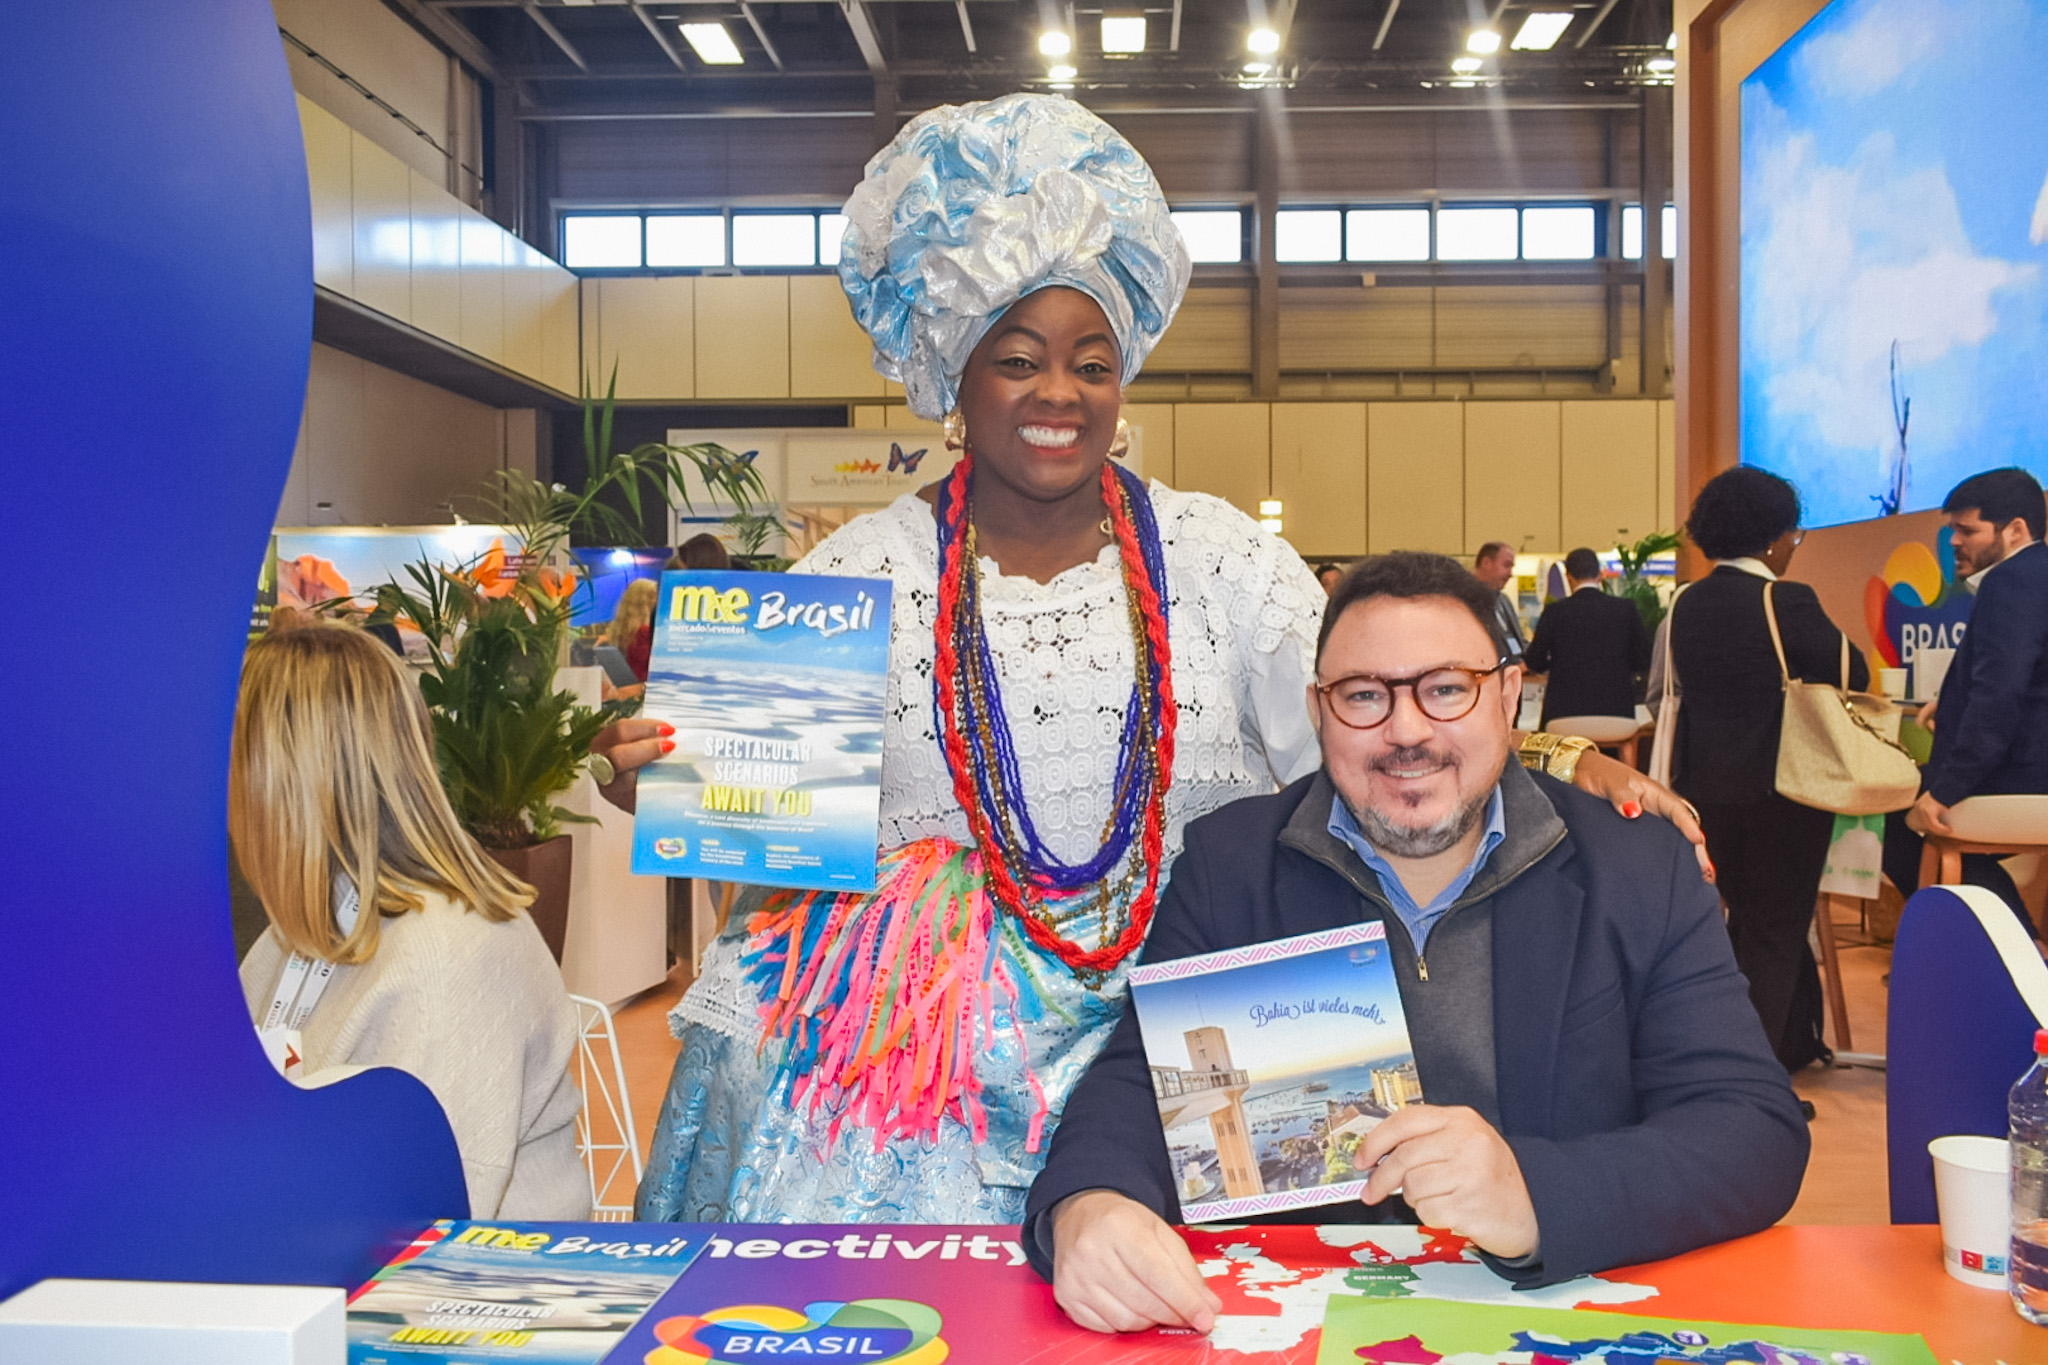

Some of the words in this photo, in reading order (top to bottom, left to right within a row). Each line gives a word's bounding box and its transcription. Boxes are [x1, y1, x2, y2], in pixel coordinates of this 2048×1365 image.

[753, 590, 875, 638] Brasil
[703, 736, 813, 763] SPECTACULAR
[714, 761, 800, 786] SCENARIOS
[701, 785, 766, 815] AWAIT
[771, 788, 813, 818] YOU
[1250, 1002, 1301, 1028] Bahia
[1302, 999, 1316, 1014] ist
[1318, 997, 1350, 1014] vieles
[544, 1236, 688, 1259] Brasil
[425, 1300, 555, 1319] SPECTACULAR
[422, 1314, 531, 1331] SCENARIOS
[389, 1326, 475, 1346] AWAIT
[478, 1330, 538, 1349] YOU
[723, 1336, 884, 1356] BRASIL
